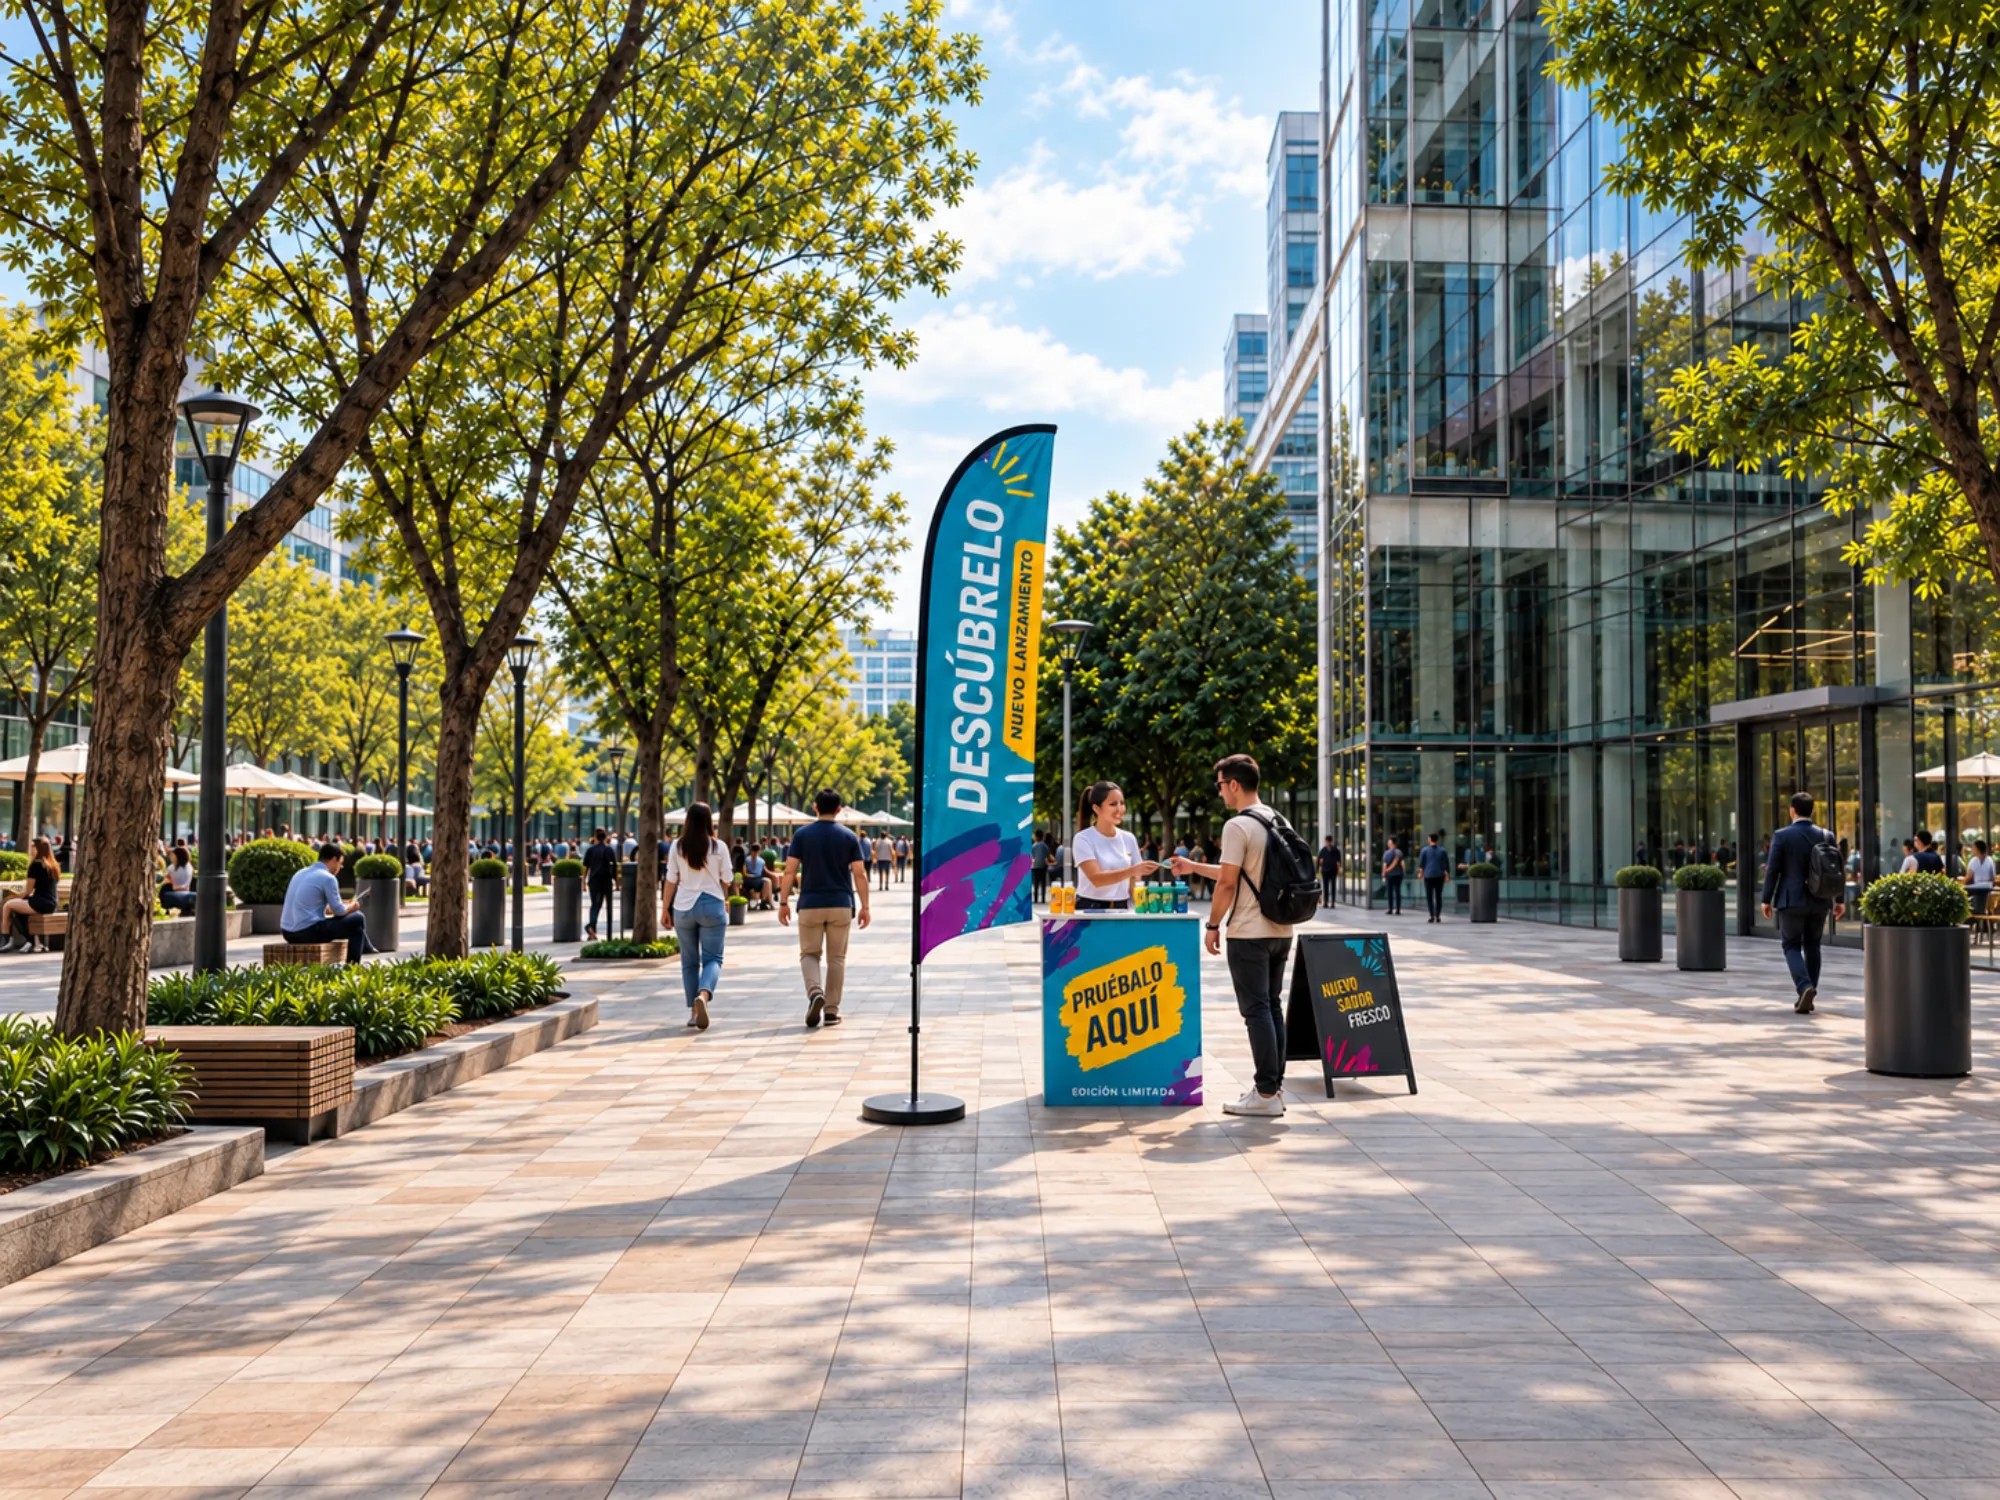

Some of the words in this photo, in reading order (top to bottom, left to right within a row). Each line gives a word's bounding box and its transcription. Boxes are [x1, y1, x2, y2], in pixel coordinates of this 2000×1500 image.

[1015, 549, 1034, 670] LANZAMIENTO
[945, 499, 1005, 813] DESCÚBRELO
[1011, 677, 1026, 740] NUEVO
[1072, 961, 1163, 1013] PRUÉBALO
[1321, 976, 1358, 998] NUEVO
[1086, 985, 1160, 1053] AQUÍ
[1348, 1005, 1391, 1028] FRESCO
[1121, 1087, 1175, 1097] LIMITADA
